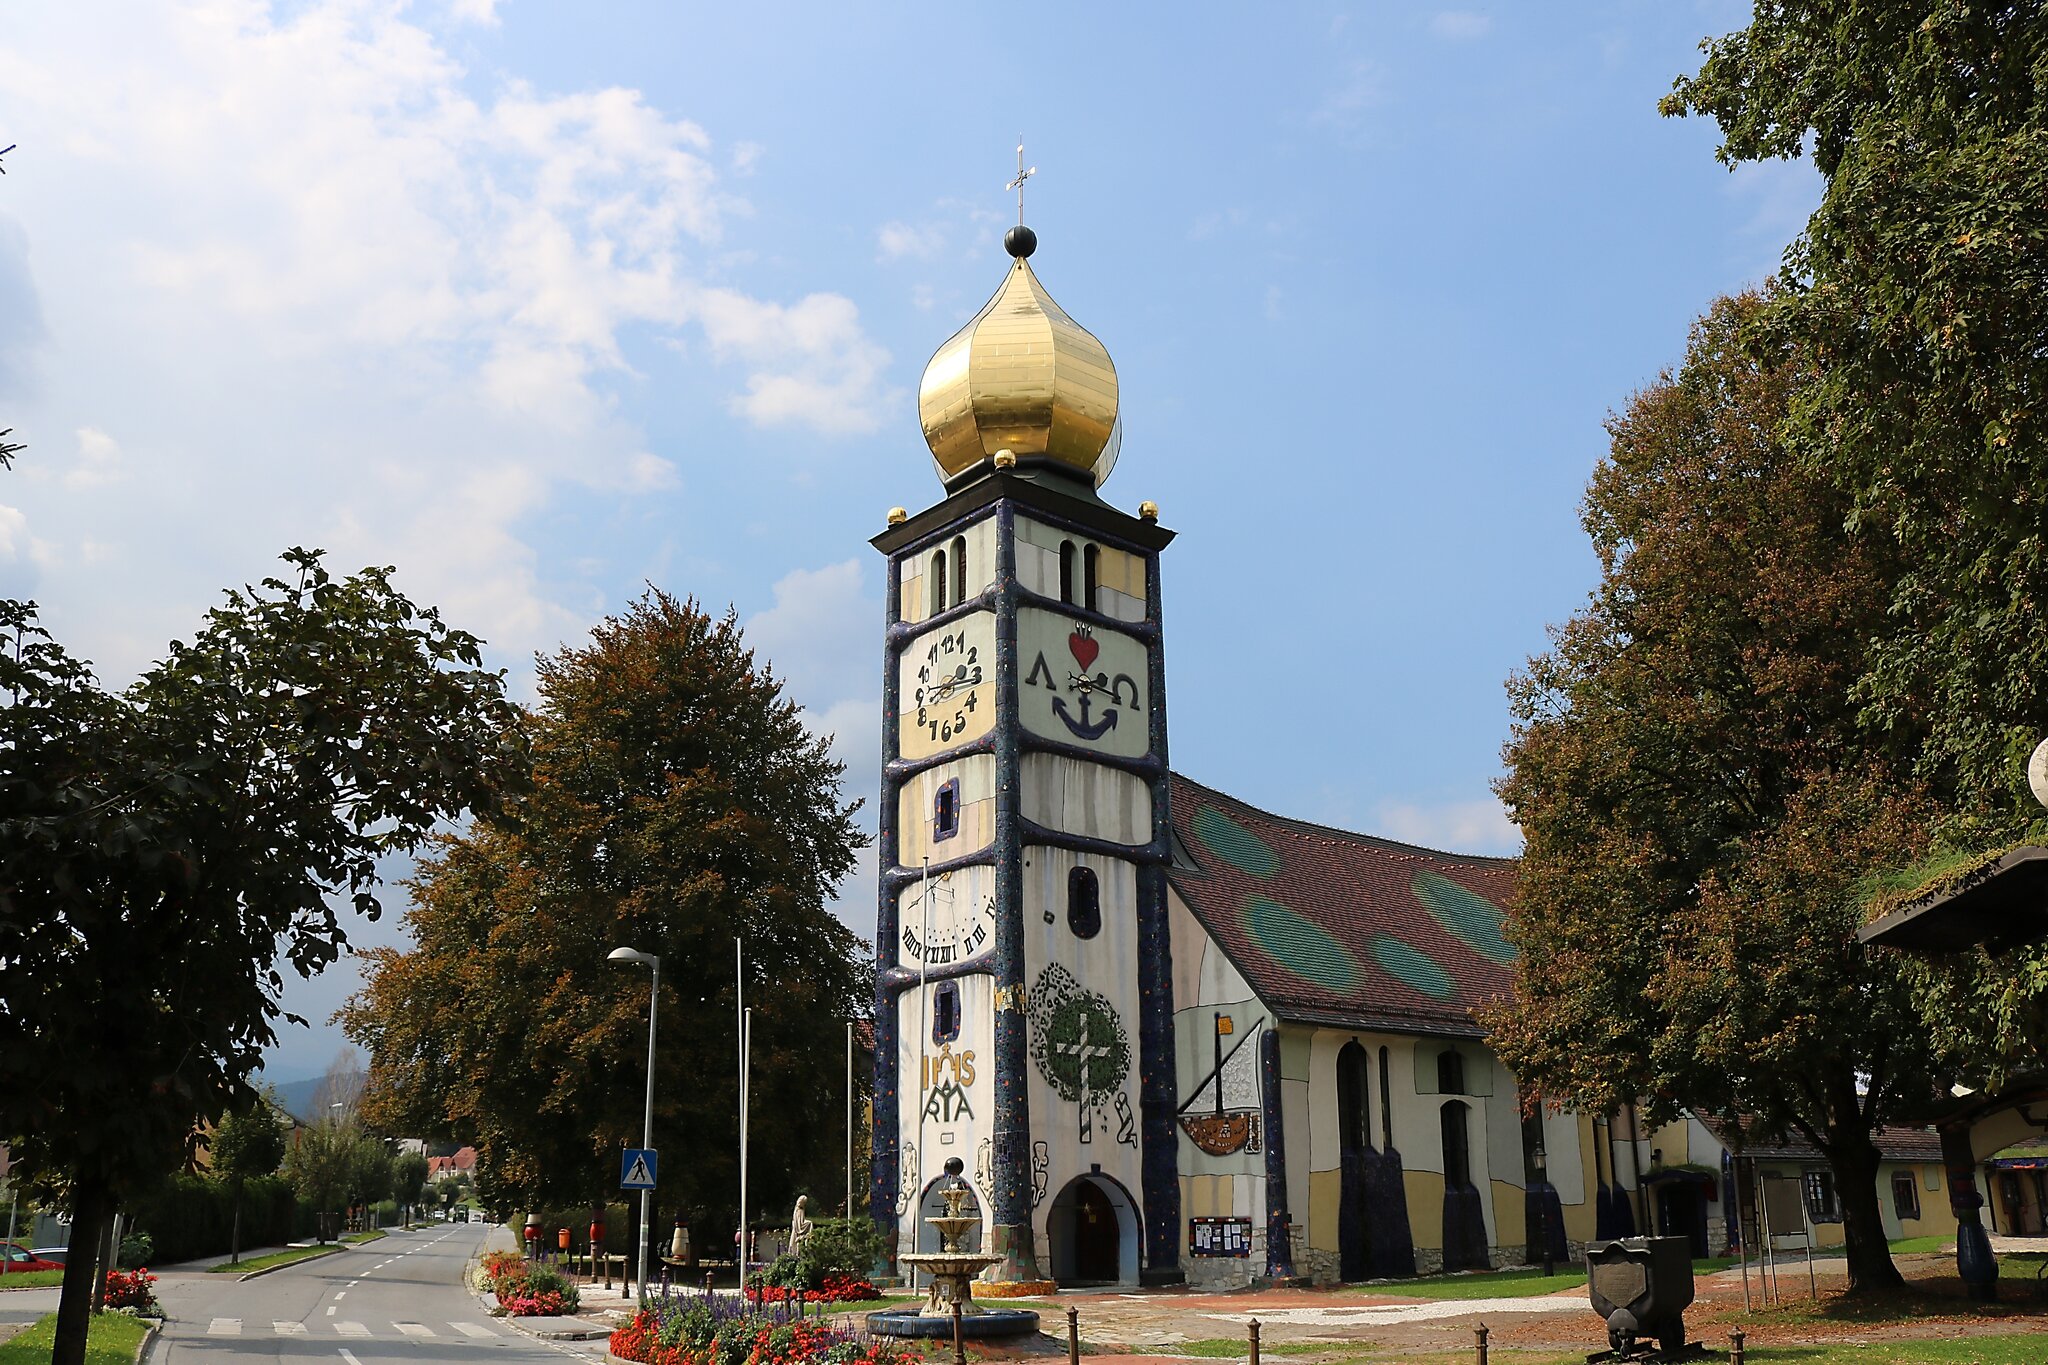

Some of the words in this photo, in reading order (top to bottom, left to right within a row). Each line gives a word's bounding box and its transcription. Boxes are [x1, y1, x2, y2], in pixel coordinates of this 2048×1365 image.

[941, 634, 954, 654] 12
[956, 630, 965, 654] 1
[927, 643, 938, 666] 11
[967, 647, 977, 665] 2
[918, 665, 930, 684] 10
[971, 666, 982, 684] 3
[915, 688, 925, 708] 9
[964, 690, 977, 712] 4
[917, 707, 927, 727] 8
[953, 710, 966, 733] 5
[929, 720, 938, 741] 7
[941, 720, 952, 742] 6
[972, 924, 986, 945] III
[964, 937, 974, 955] II
